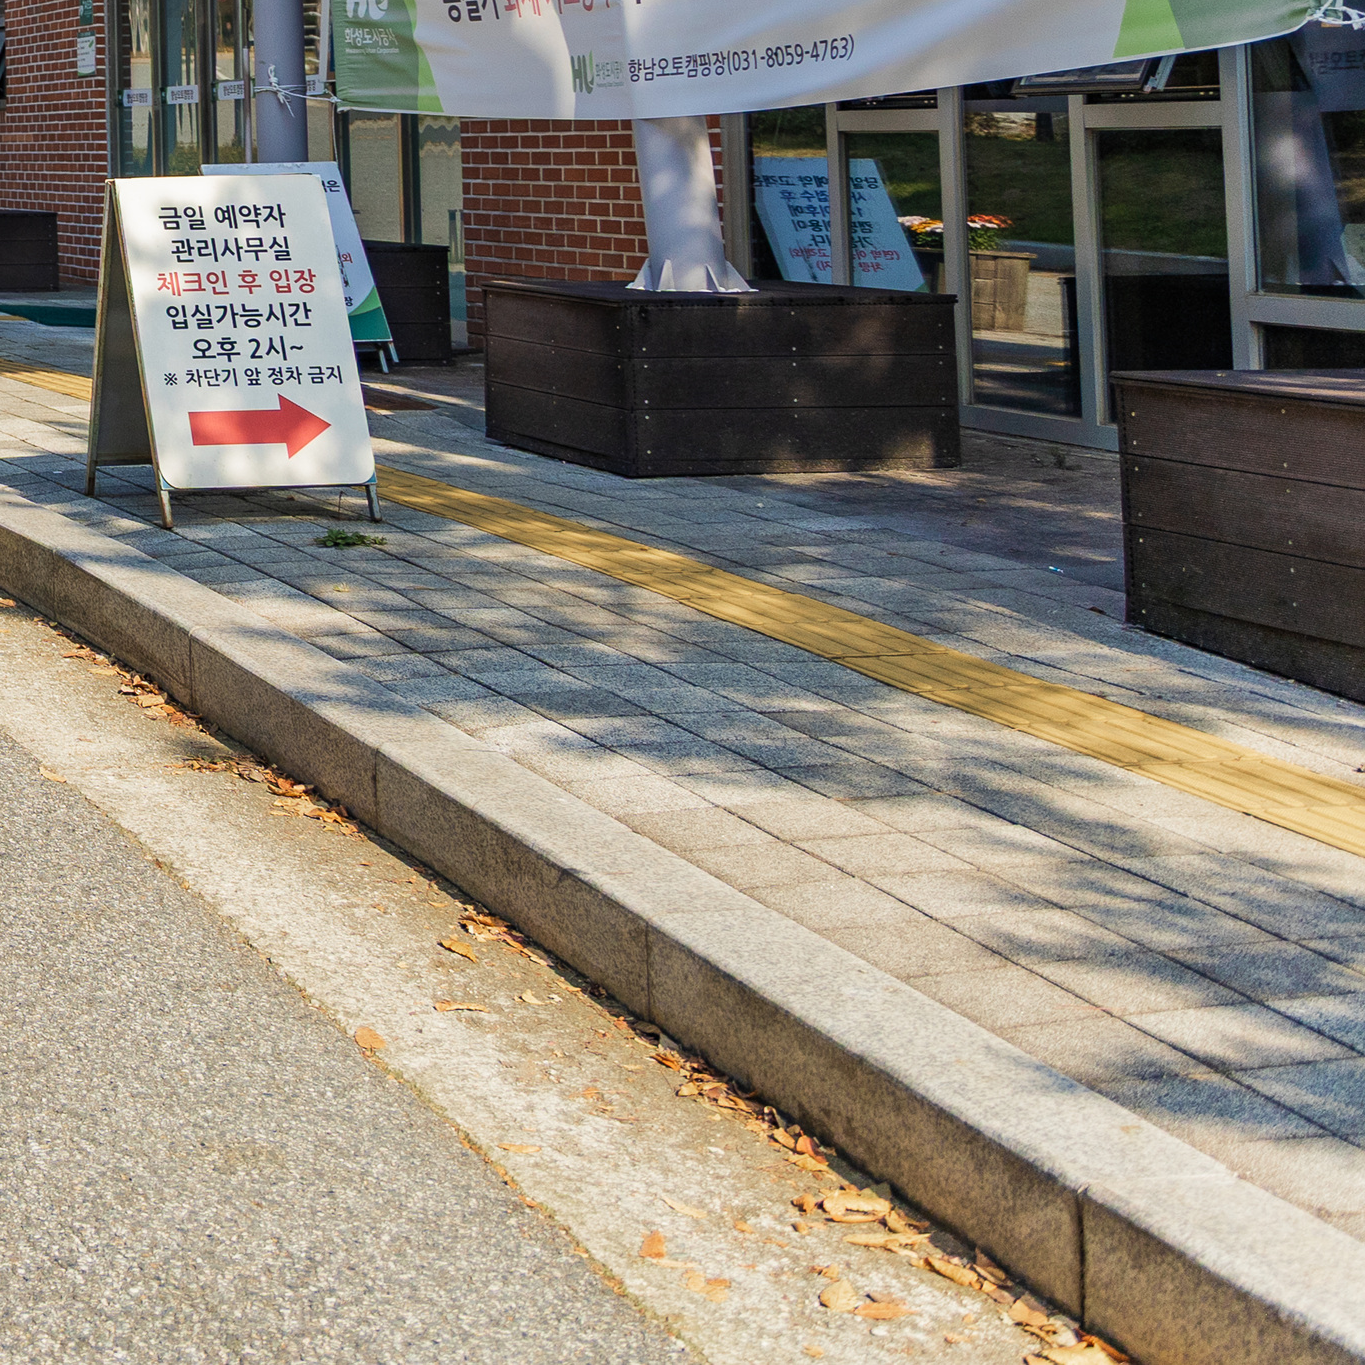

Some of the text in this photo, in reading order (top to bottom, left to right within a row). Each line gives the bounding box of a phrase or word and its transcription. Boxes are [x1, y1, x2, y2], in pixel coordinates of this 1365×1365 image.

[157, 203, 286, 231] 금일 예약자
[170, 236, 292, 263] 관리사무실
[156, 268, 317, 297] 체크인 후 입장
[165, 301, 313, 330] 입실가능시간
[192, 336, 241, 362] 오후
[185, 367, 239, 388] 차단기
[244, 366, 262, 387] 앞
[267, 365, 303, 385] 정차
[307, 364, 344, 385] 금지
